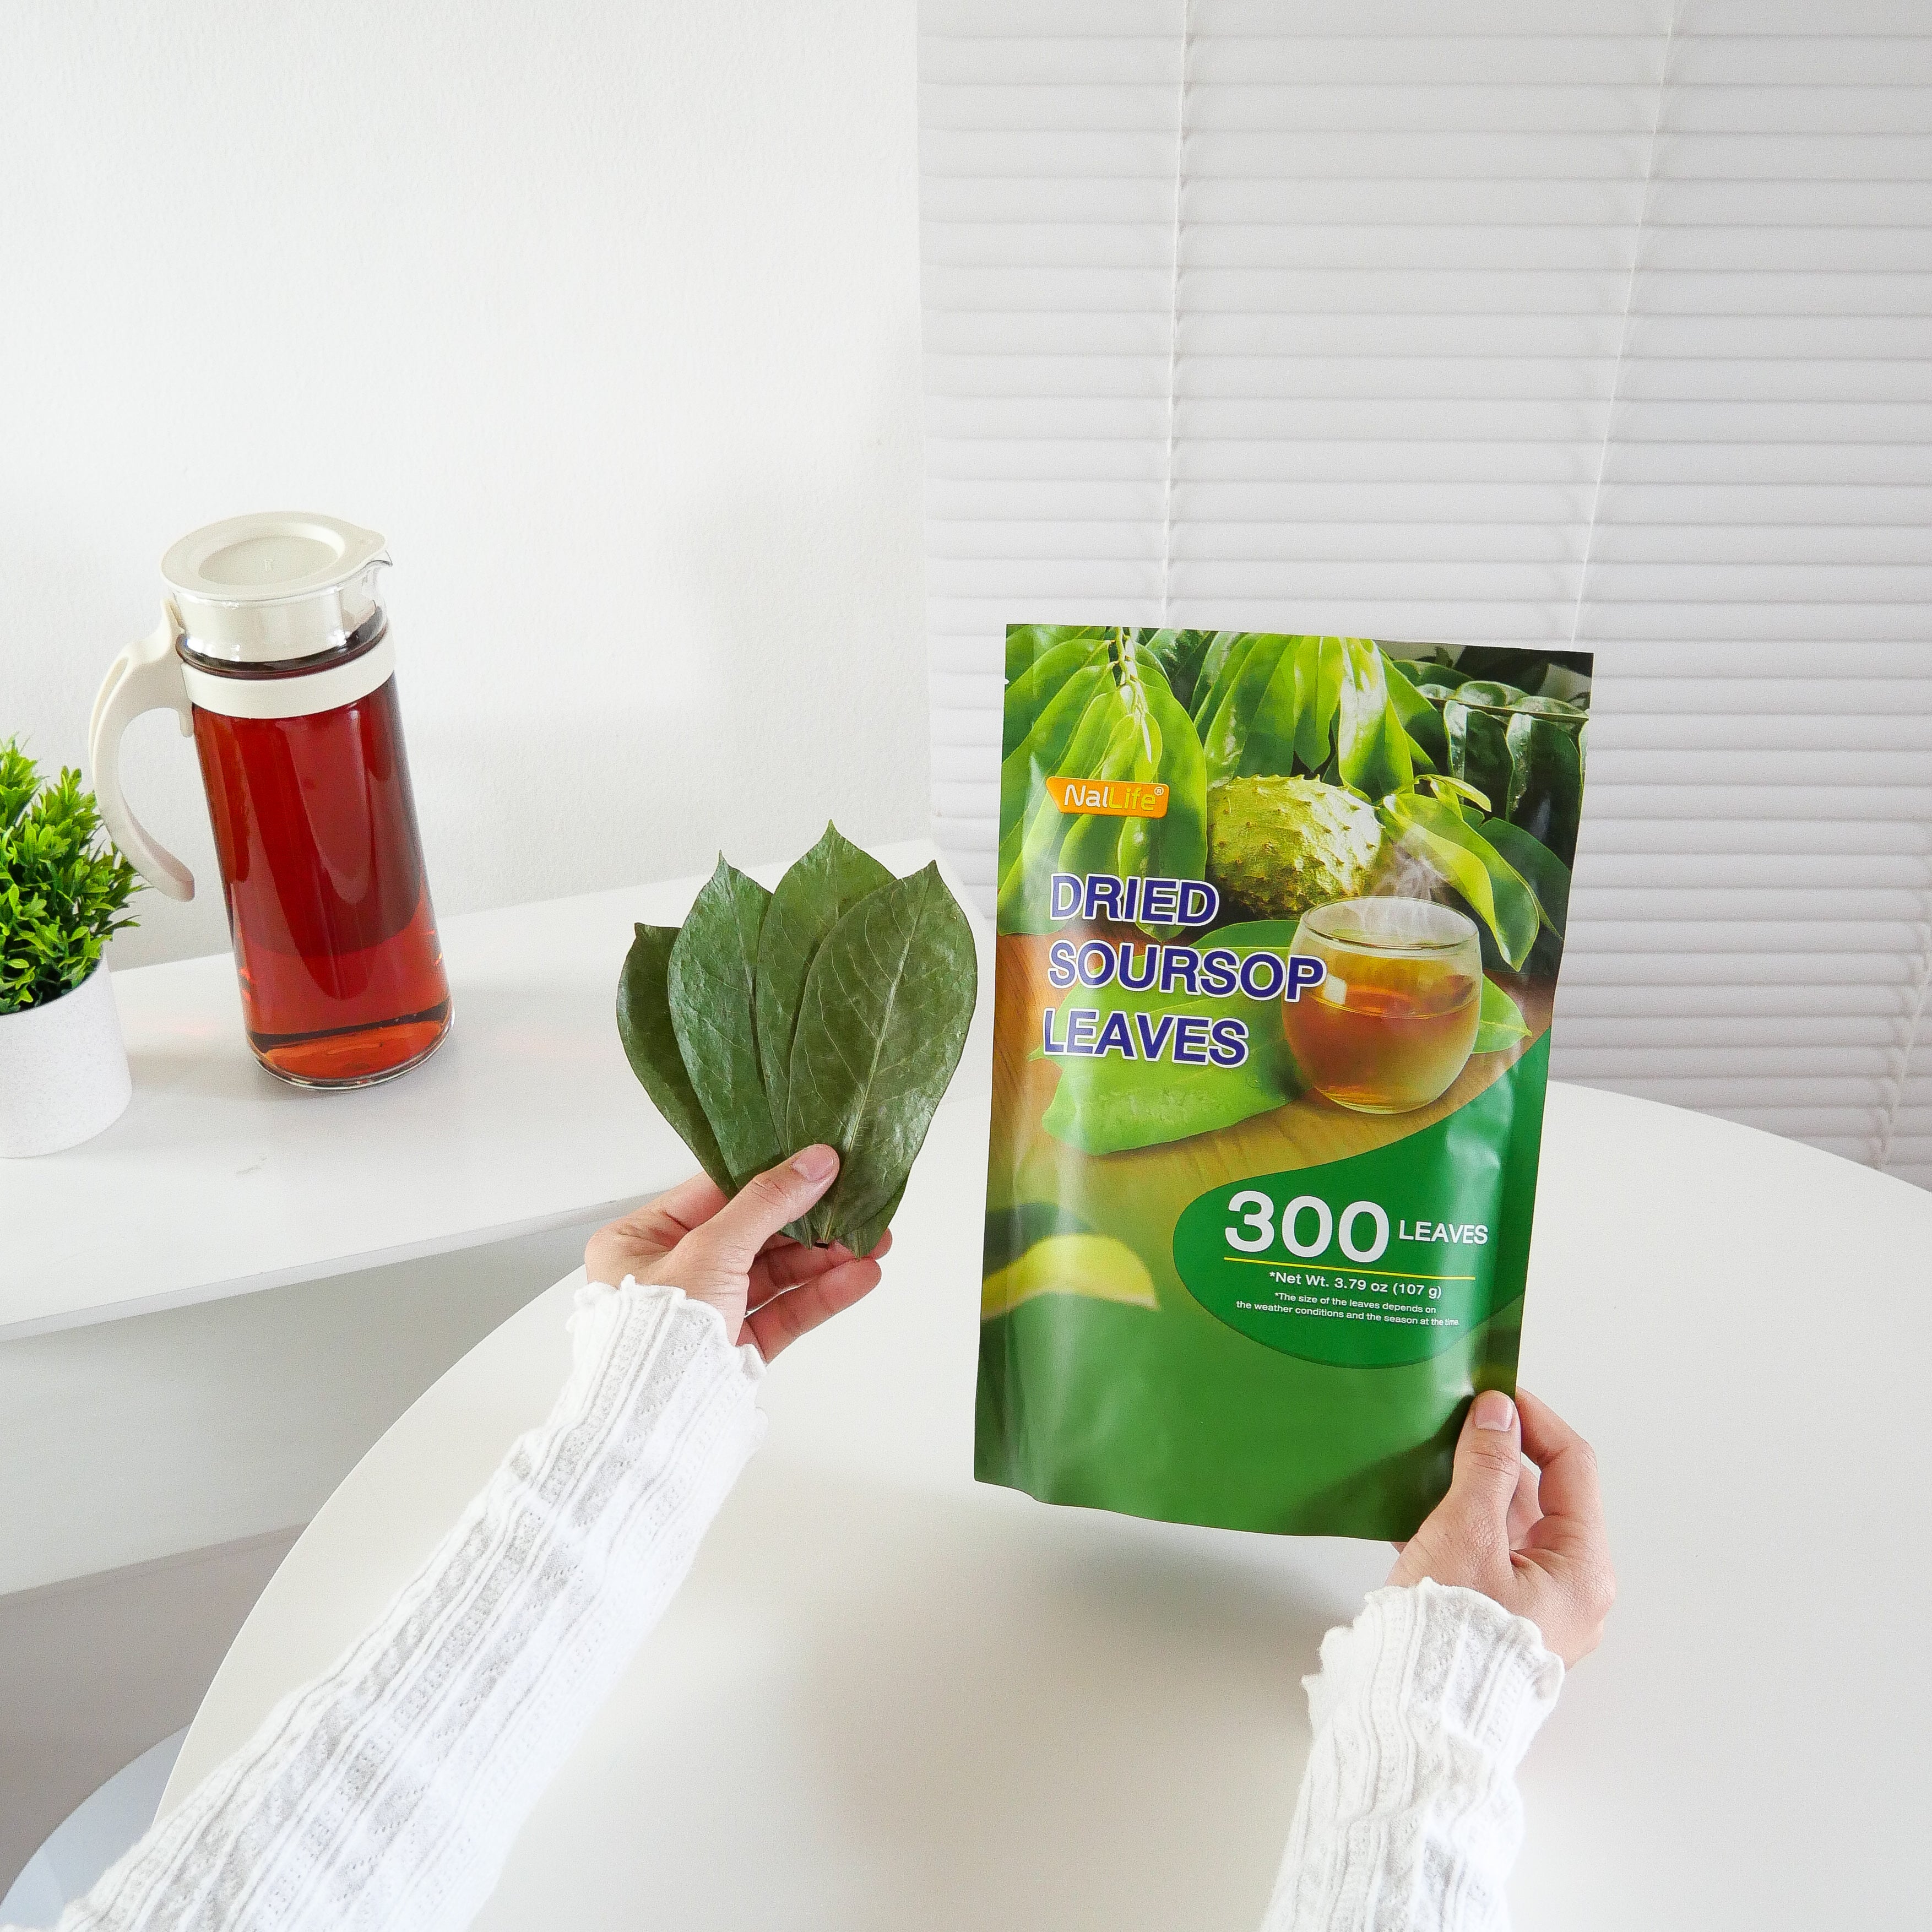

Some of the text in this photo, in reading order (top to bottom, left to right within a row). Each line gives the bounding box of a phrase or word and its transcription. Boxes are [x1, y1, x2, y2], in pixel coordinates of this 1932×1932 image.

[1050, 872, 1219, 926] DRIED
[1048, 939, 1326, 1002] SOURSOP
[1043, 1008, 1249, 1068] LEAVES
[1224, 1190, 1488, 1263] 300 LEAVES
[1236, 1300, 1252, 1309] the
[1254, 1303, 1293, 1313] weather
[1295, 1307, 1344, 1318] conditions
[1346, 1312, 1364, 1320] and
[1366, 1313, 1382, 1321] the
[1383, 1316, 1418, 1324] season
[1298, 1295, 1317, 1304] size
[1320, 1296, 1330, 1305] of
[1332, 1298, 1347, 1306] the
[1349, 1299, 1380, 1309] leaves
[1382, 1303, 1423, 1312] depends
[1305, 1274, 1329, 1287] Wt.
[1334, 1277, 1366, 1290] 3.79
[1370, 1283, 1388, 1293] oz
[1393, 1283, 1425, 1295] (107
[1428, 1286, 1442, 1299] g)
